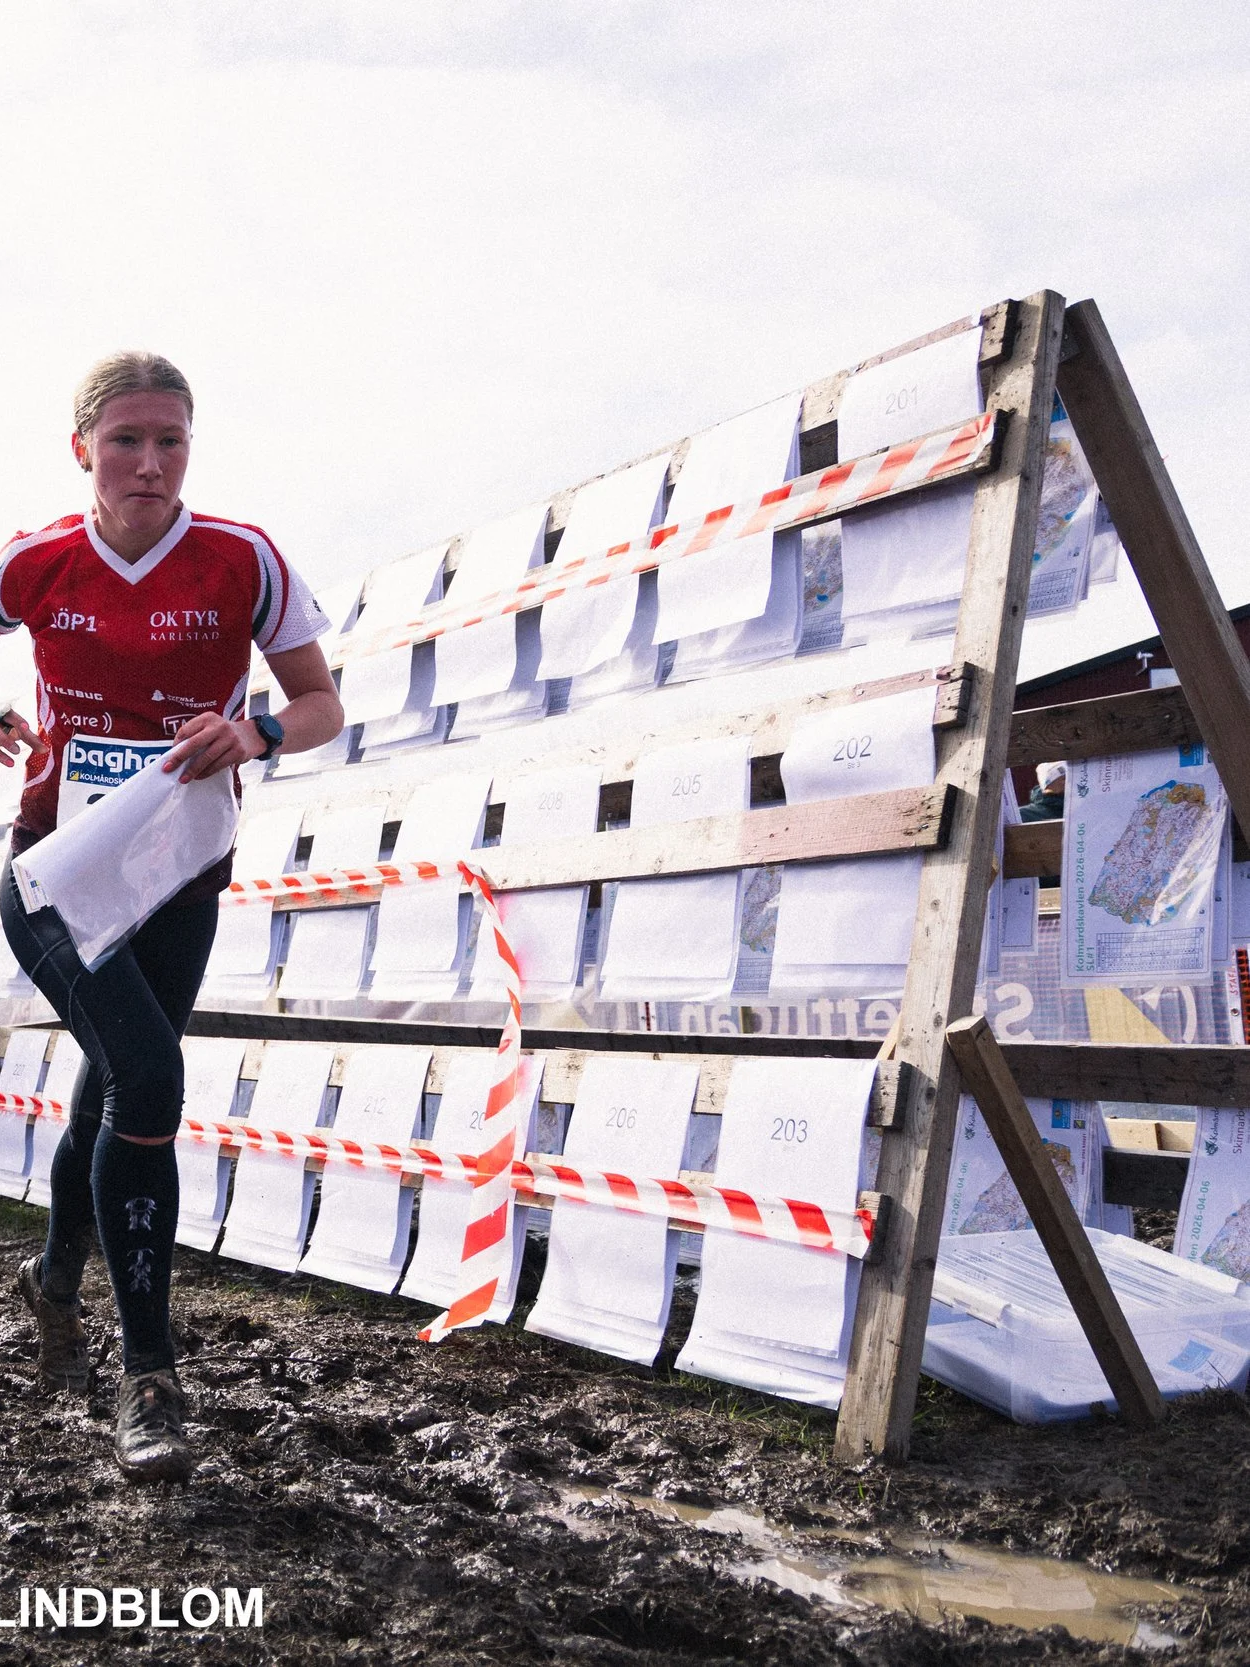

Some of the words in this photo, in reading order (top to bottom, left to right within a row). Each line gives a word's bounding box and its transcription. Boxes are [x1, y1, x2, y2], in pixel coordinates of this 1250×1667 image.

[885, 385, 918, 414] 201
[150, 611, 178, 628] OK
[182, 610, 219, 627] TYR
[150, 632, 220, 642] KARLSTAD
[833, 736, 872, 762] 202
[672, 775, 701, 797] 205
[1075, 823, 1086, 882] 2026-04-06
[1075, 885, 1086, 972] Kolmårdskavlen
[1087, 946, 1095, 971] SL#1
[363, 1097, 387, 1114] 212
[606, 1107, 638, 1128] 206
[469, 1111, 484, 1130] 20
[770, 1117, 808, 1144] 203
[1191, 1181, 1211, 1240] 2026-04-06
